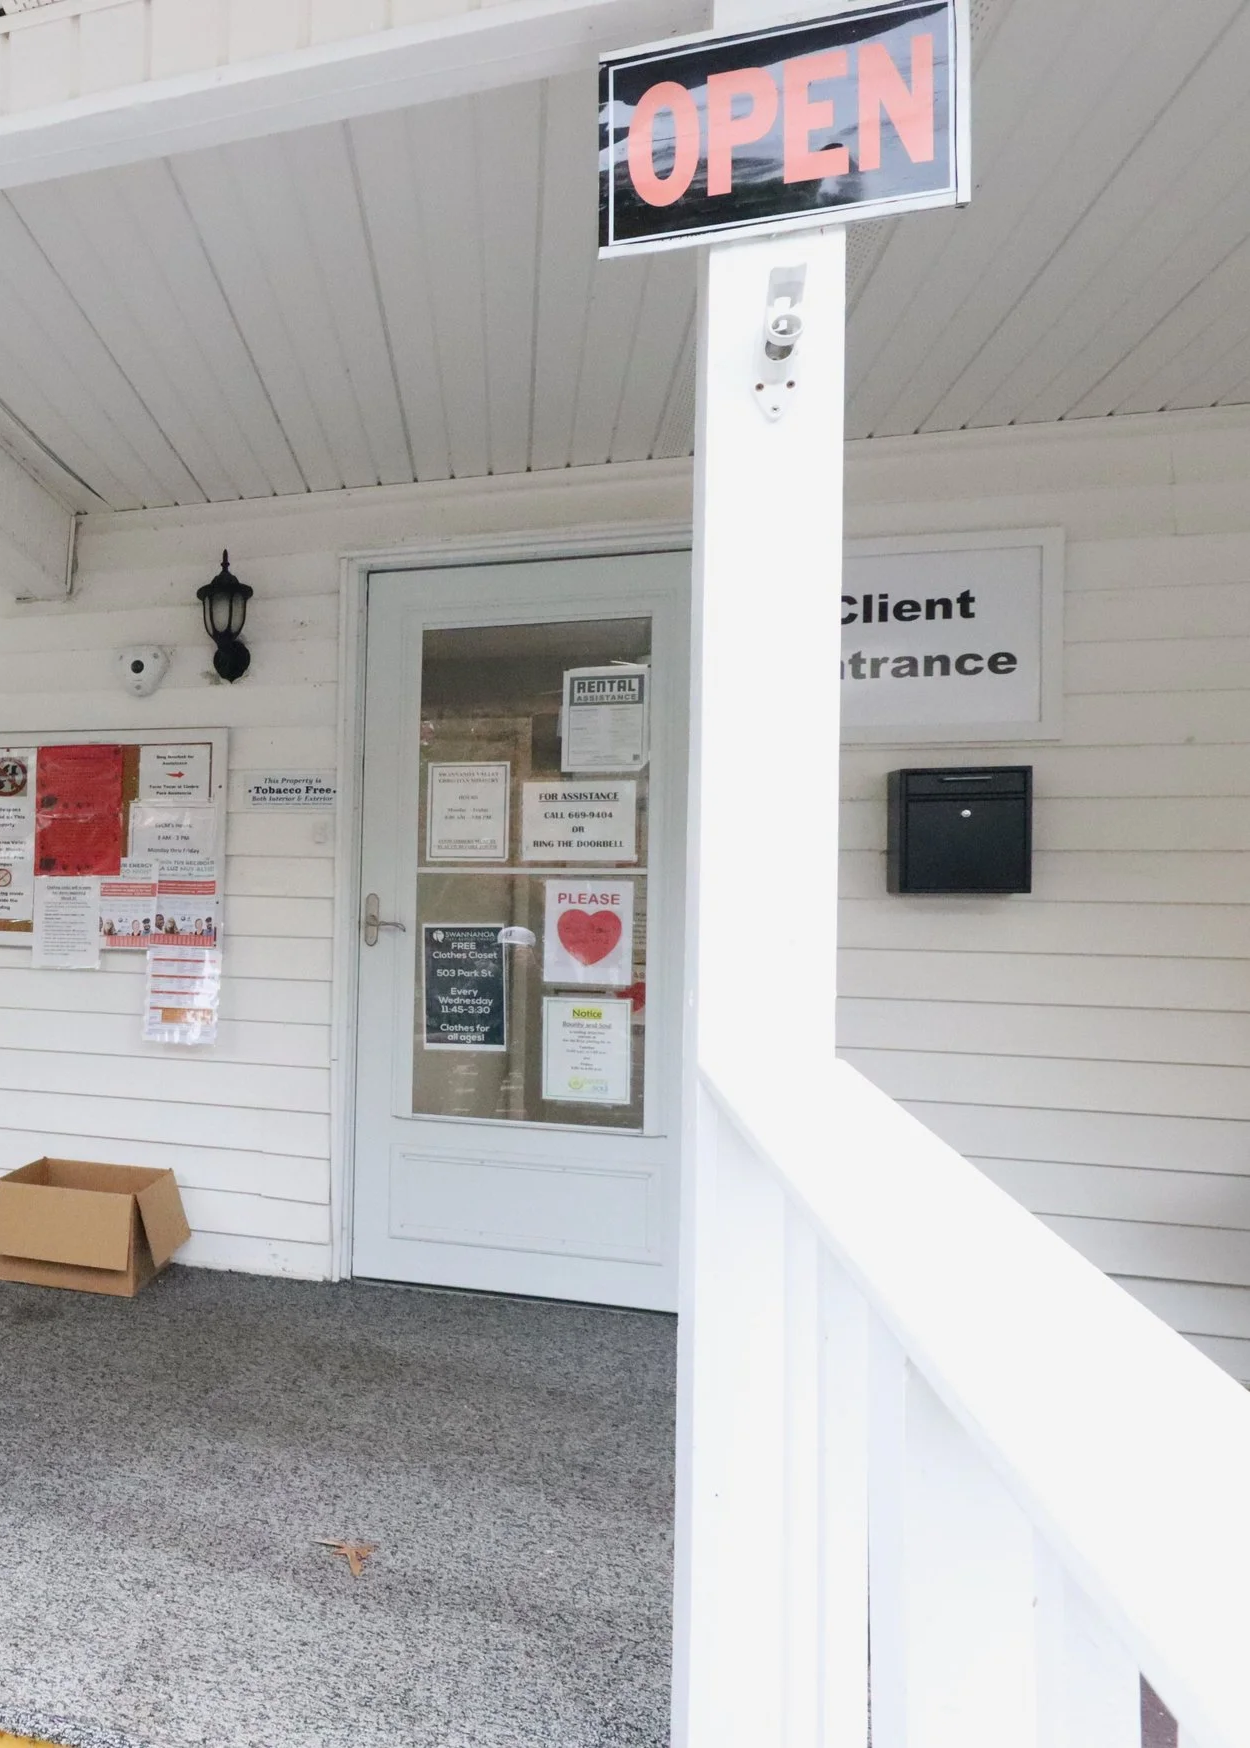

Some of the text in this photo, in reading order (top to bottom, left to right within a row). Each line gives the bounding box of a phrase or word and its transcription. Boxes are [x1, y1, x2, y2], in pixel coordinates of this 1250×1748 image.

[627, 32, 935, 208] OPEN
[840, 651, 1017, 679] trance
[577, 680, 636, 693] RENTAL
[254, 786, 332, 794] Tobacco Free
[561, 792, 619, 800] ASSISTANCE
[544, 811, 613, 819] CALL 669-9404
[533, 840, 624, 848] RING THE DOORBELL
[557, 893, 621, 905] PLEASE
[451, 942, 476, 950] FREE
[432, 951, 498, 959] Clothes Closet
[436, 969, 494, 977] 503 Park St.
[450, 988, 478, 997] Every
[438, 996, 493, 1006] Wednesday
[441, 1006, 490, 1014] 11:45-3:30
[572, 1009, 602, 1018] Notice
[440, 1024, 490, 1032] Clothes for
[447, 1033, 485, 1044] all ages!
